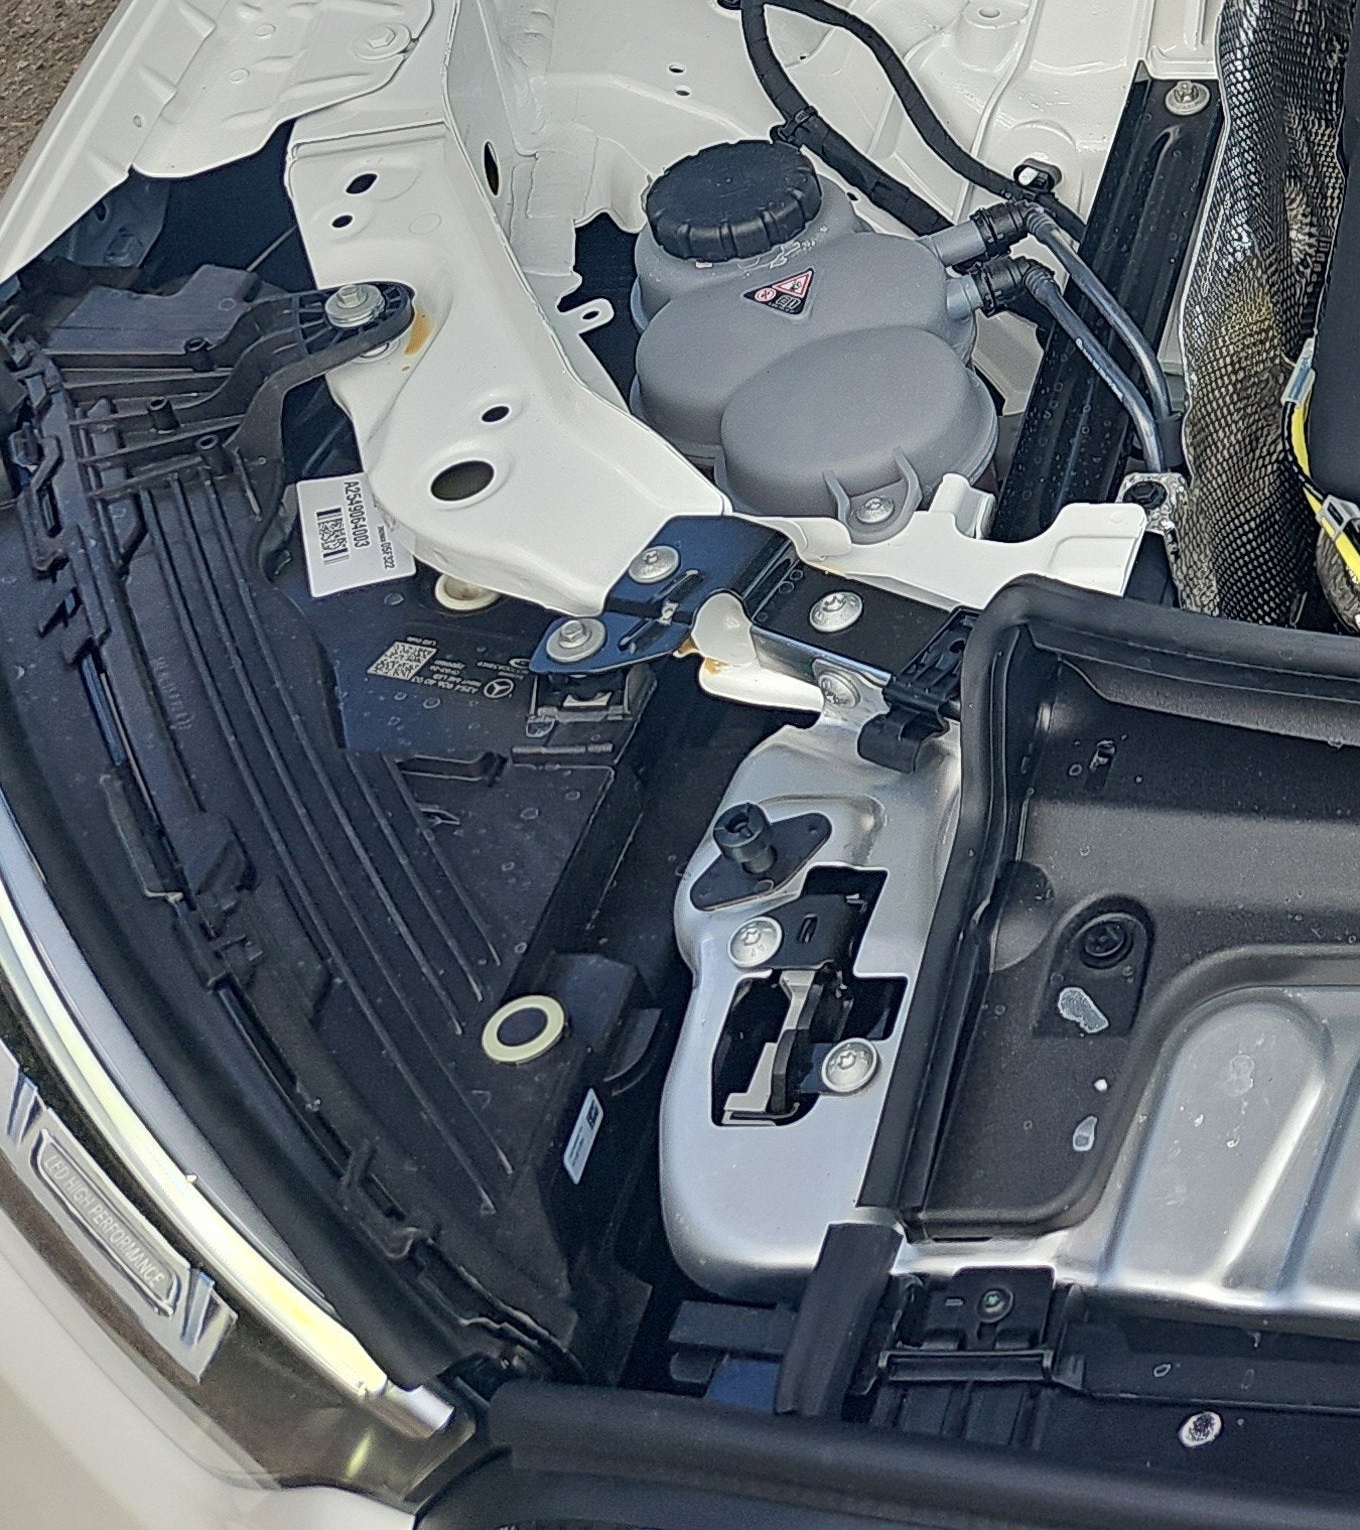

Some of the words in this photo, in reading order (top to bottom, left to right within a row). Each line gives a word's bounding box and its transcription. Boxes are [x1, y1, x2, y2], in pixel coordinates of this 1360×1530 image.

[343, 480, 370, 548] A2549064003
[44, 1156, 71, 1179] LED
[62, 1178, 95, 1210] HIGH
[87, 1205, 165, 1287] PERFORMANCE
